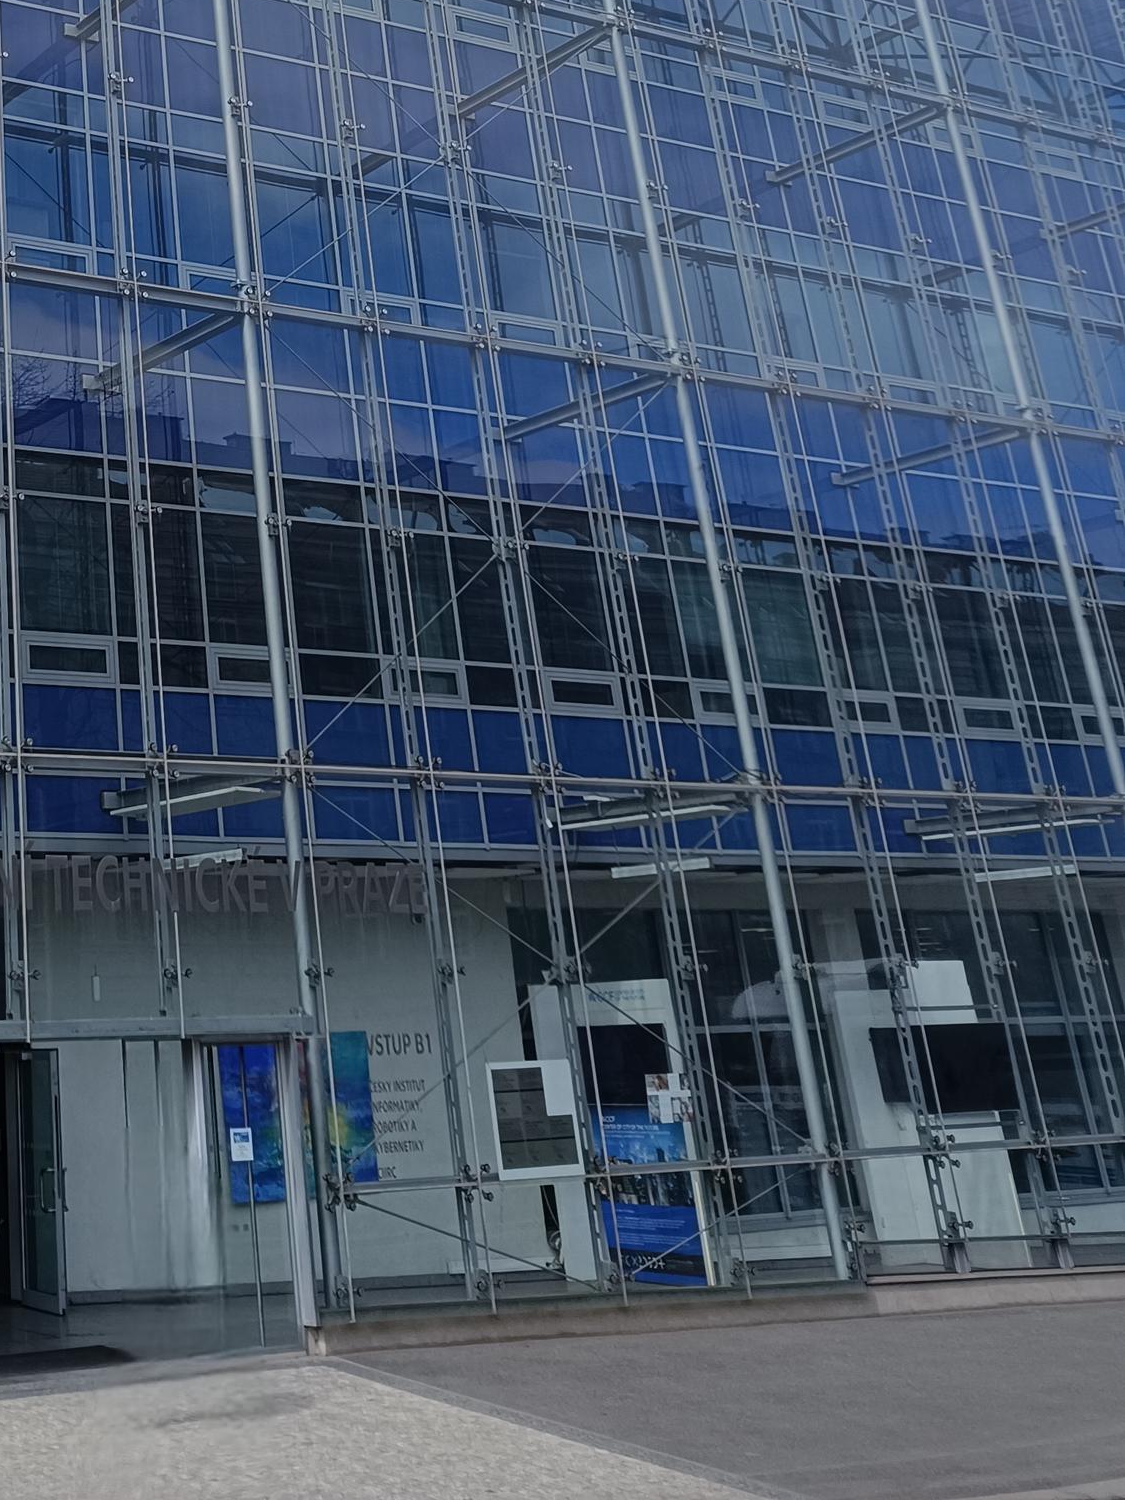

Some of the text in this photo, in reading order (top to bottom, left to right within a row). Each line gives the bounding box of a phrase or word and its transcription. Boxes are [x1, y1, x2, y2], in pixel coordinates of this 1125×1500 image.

[45, 845, 269, 912] TECHNICKÉ
[275, 859, 302, 912] V
[315, 861, 427, 914] PRAZE
[366, 1032, 433, 1056] VSTUP B1
[373, 1099, 423, 1113] NFORMATIKY,
